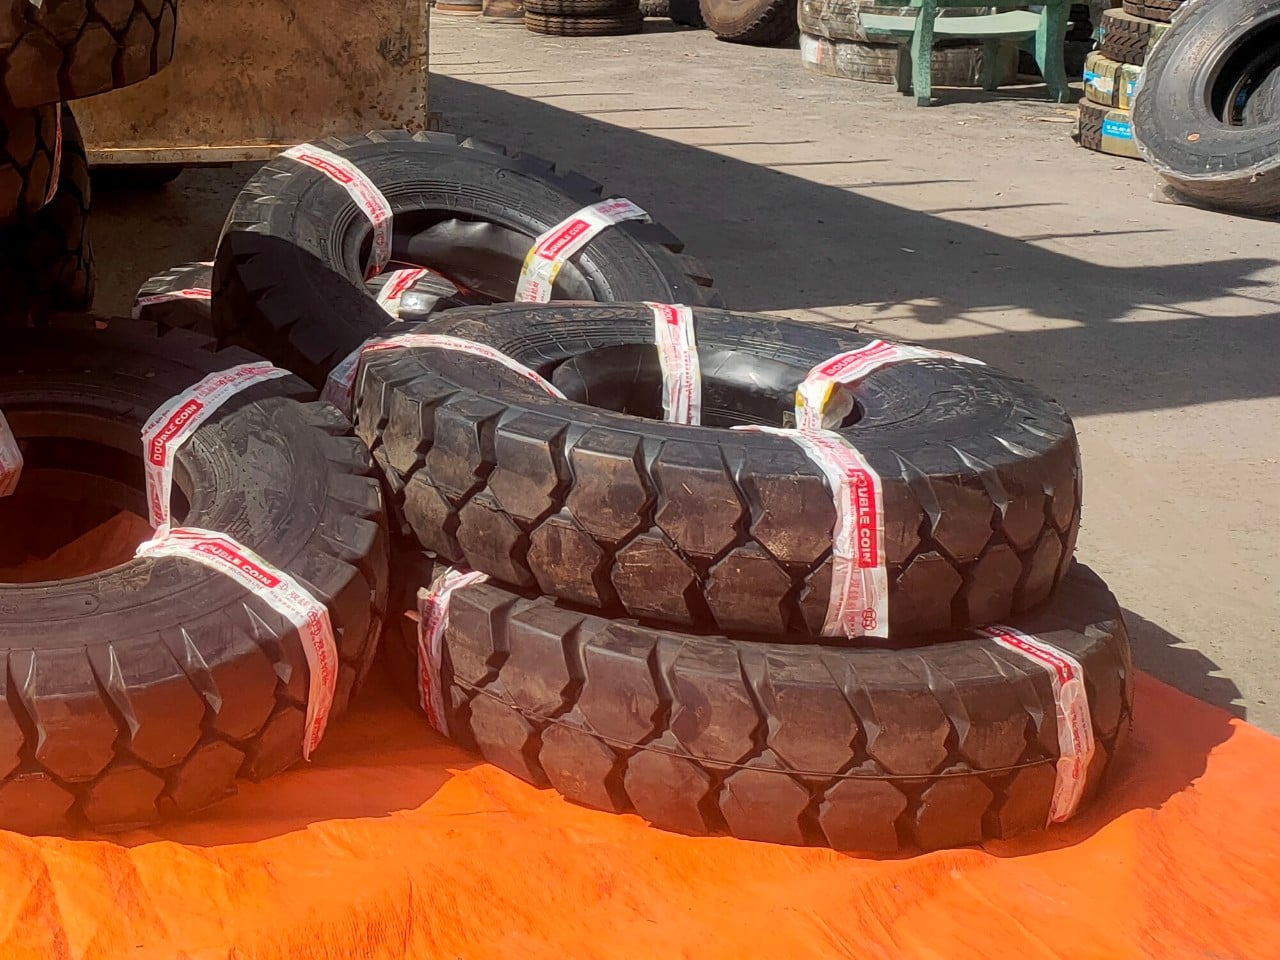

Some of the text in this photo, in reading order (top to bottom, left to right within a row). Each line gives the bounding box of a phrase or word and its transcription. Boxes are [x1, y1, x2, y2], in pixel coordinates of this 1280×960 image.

[176, 404, 198, 426] COIN
[858, 528, 872, 565] COIN
[242, 563, 273, 587] COIN
